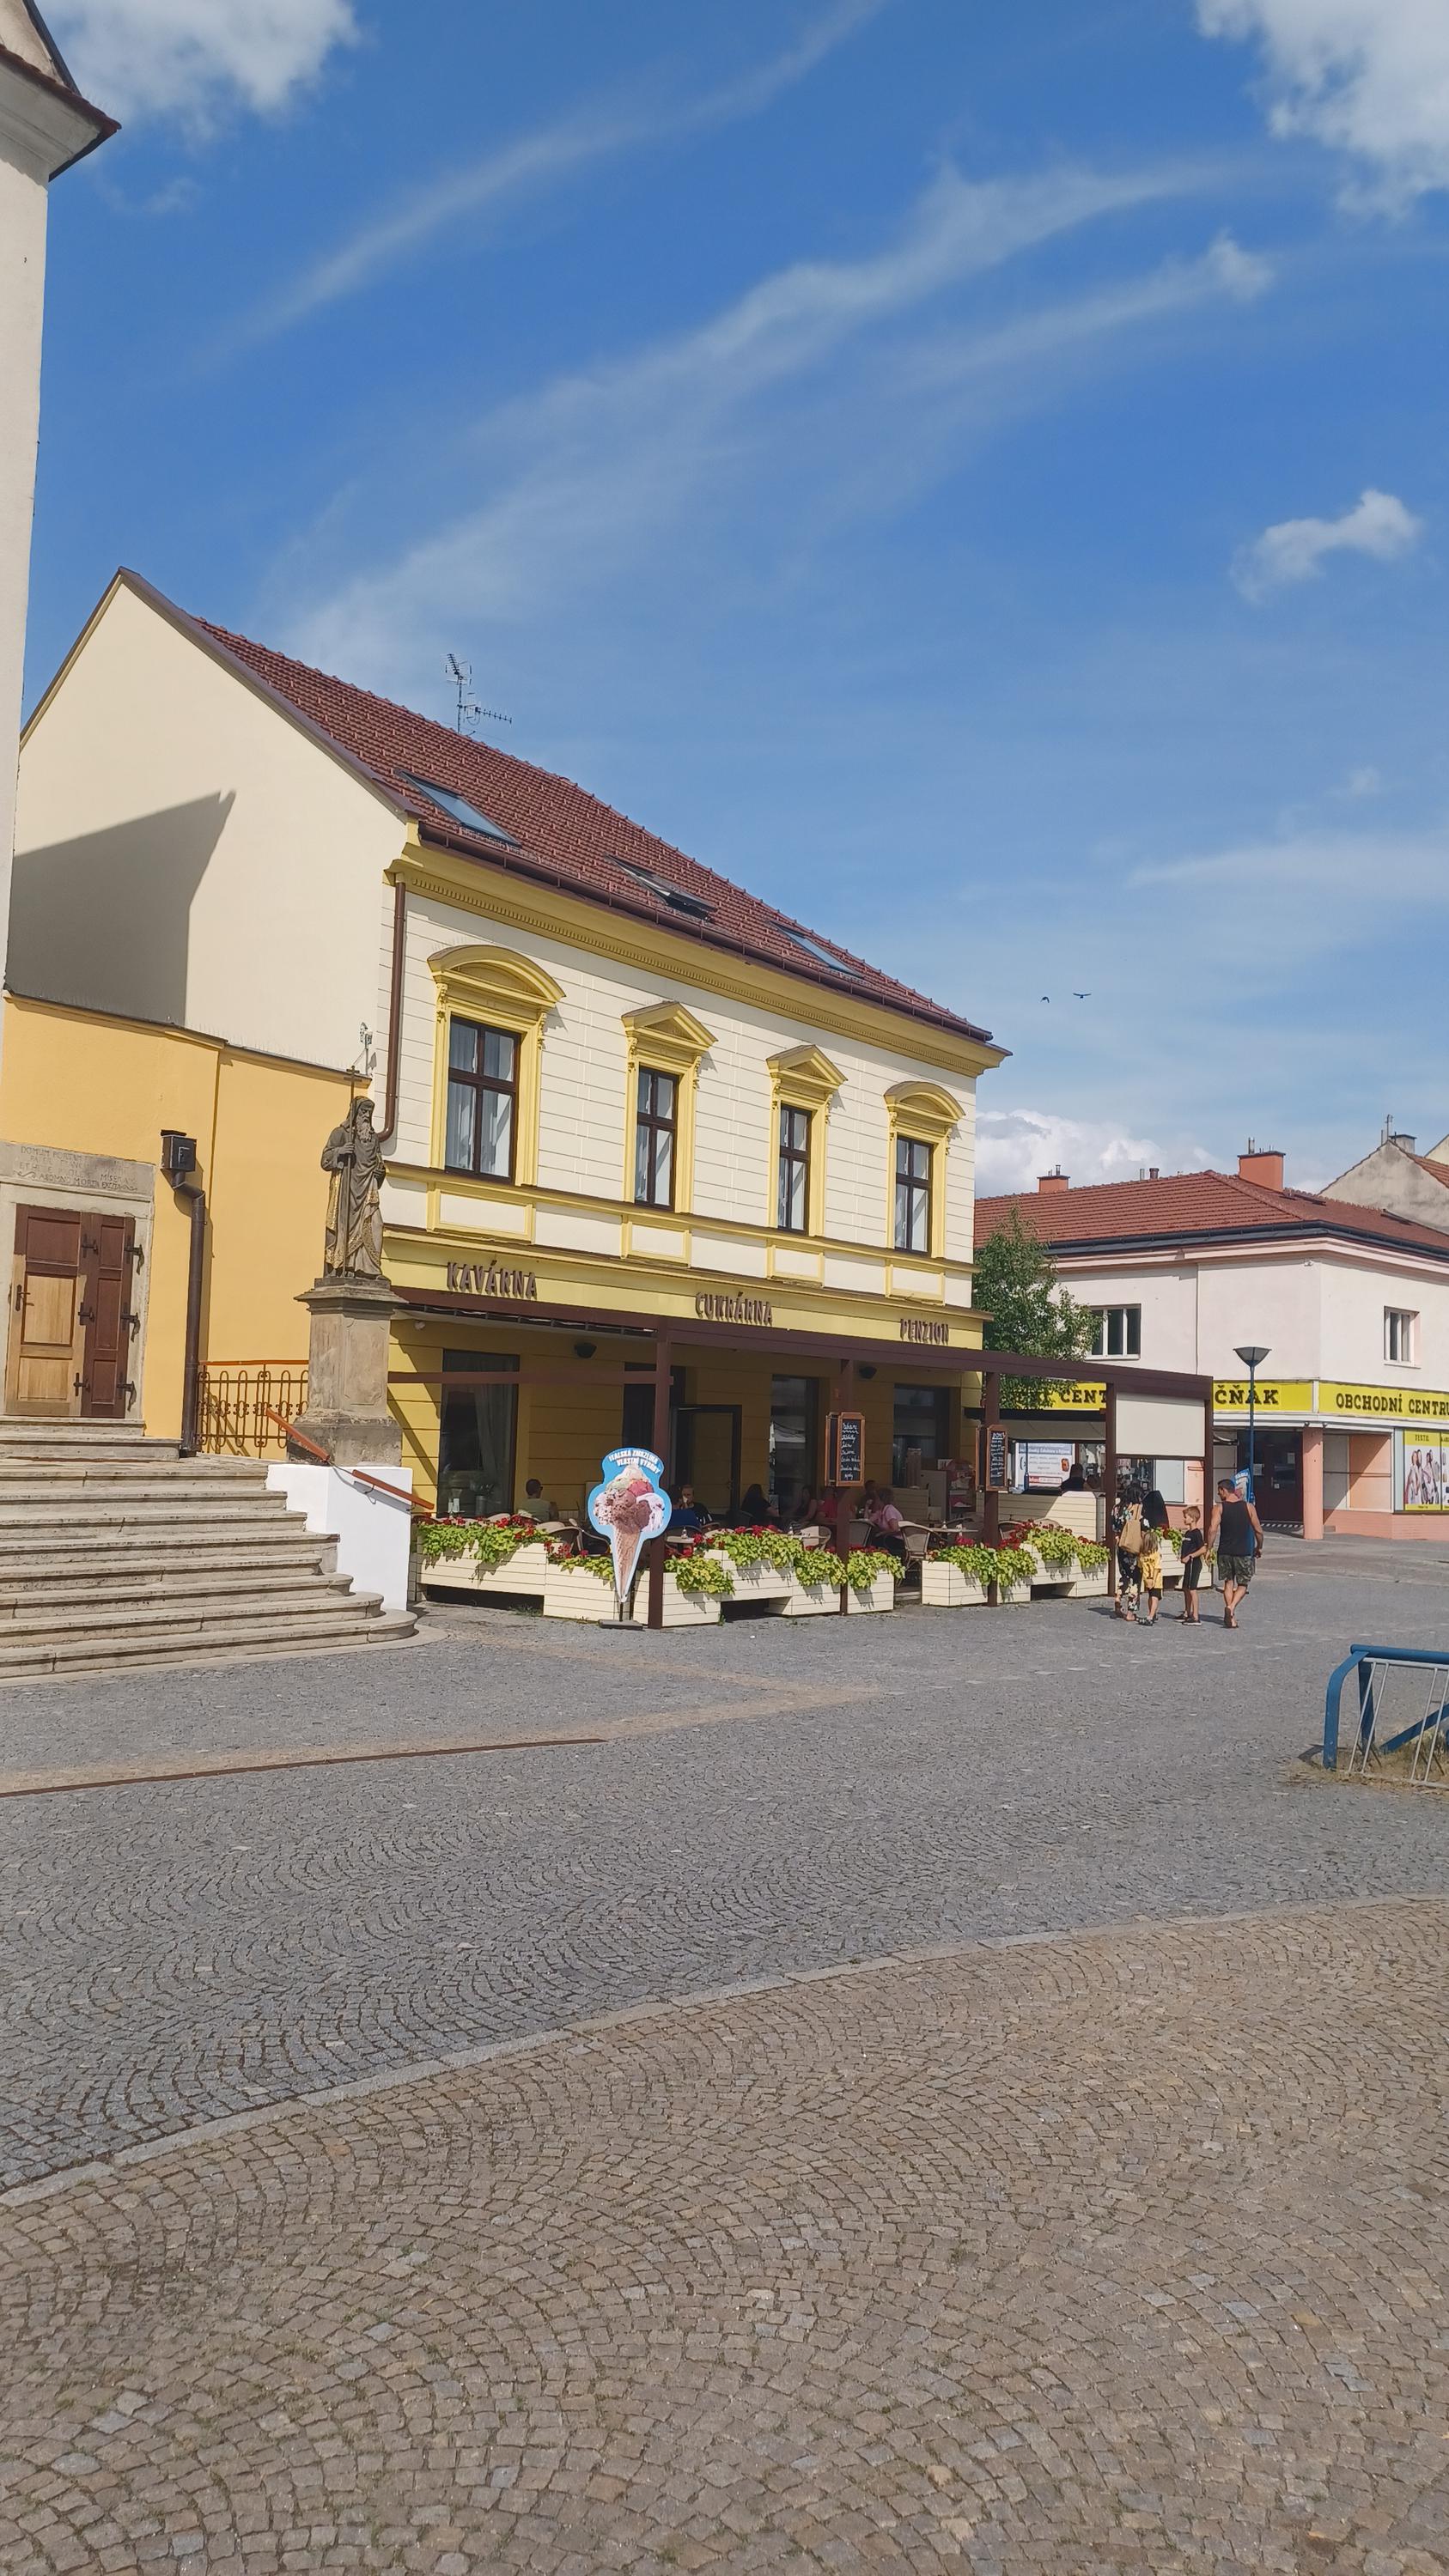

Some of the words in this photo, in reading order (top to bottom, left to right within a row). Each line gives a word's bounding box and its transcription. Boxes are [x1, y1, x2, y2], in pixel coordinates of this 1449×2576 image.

[447, 1260, 538, 1300] KAVÁRNA
[695, 1291, 773, 1325] CUKRÁRNA
[900, 1319, 949, 1346] PENZION
[1336, 1393, 1403, 1413] OBCHODNÍ
